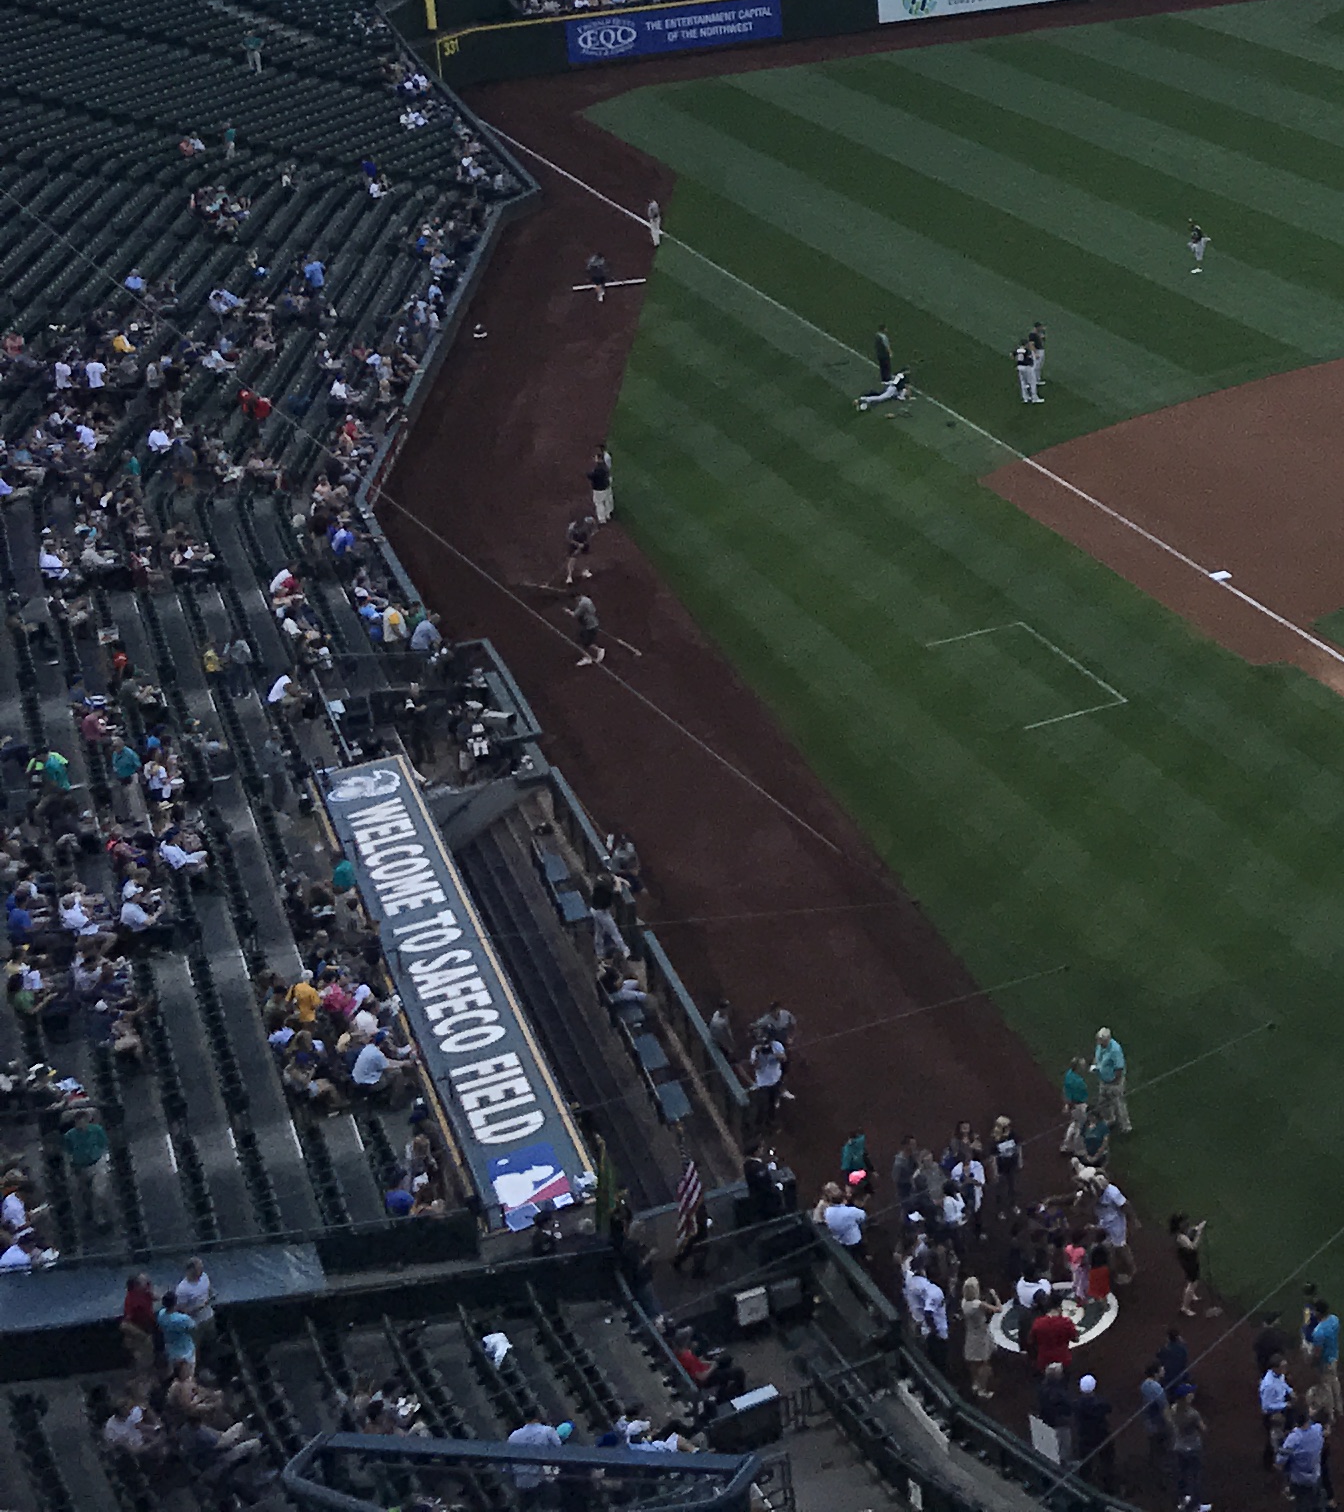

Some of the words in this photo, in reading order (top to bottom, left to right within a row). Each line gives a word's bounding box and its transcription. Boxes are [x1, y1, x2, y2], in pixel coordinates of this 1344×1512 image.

[646, 21, 662, 30] THE
[664, 14, 736, 29] ENTERTAINMENT
[738, 6, 772, 19] CAPITAL
[681, 29, 698, 39] THE
[700, 22, 753, 36] NORTHWEST
[347, 797, 448, 917] WELCOME
[392, 909, 463, 953] TO
[409, 949, 506, 1053] SAFECO
[449, 1051, 546, 1146] FIELD
